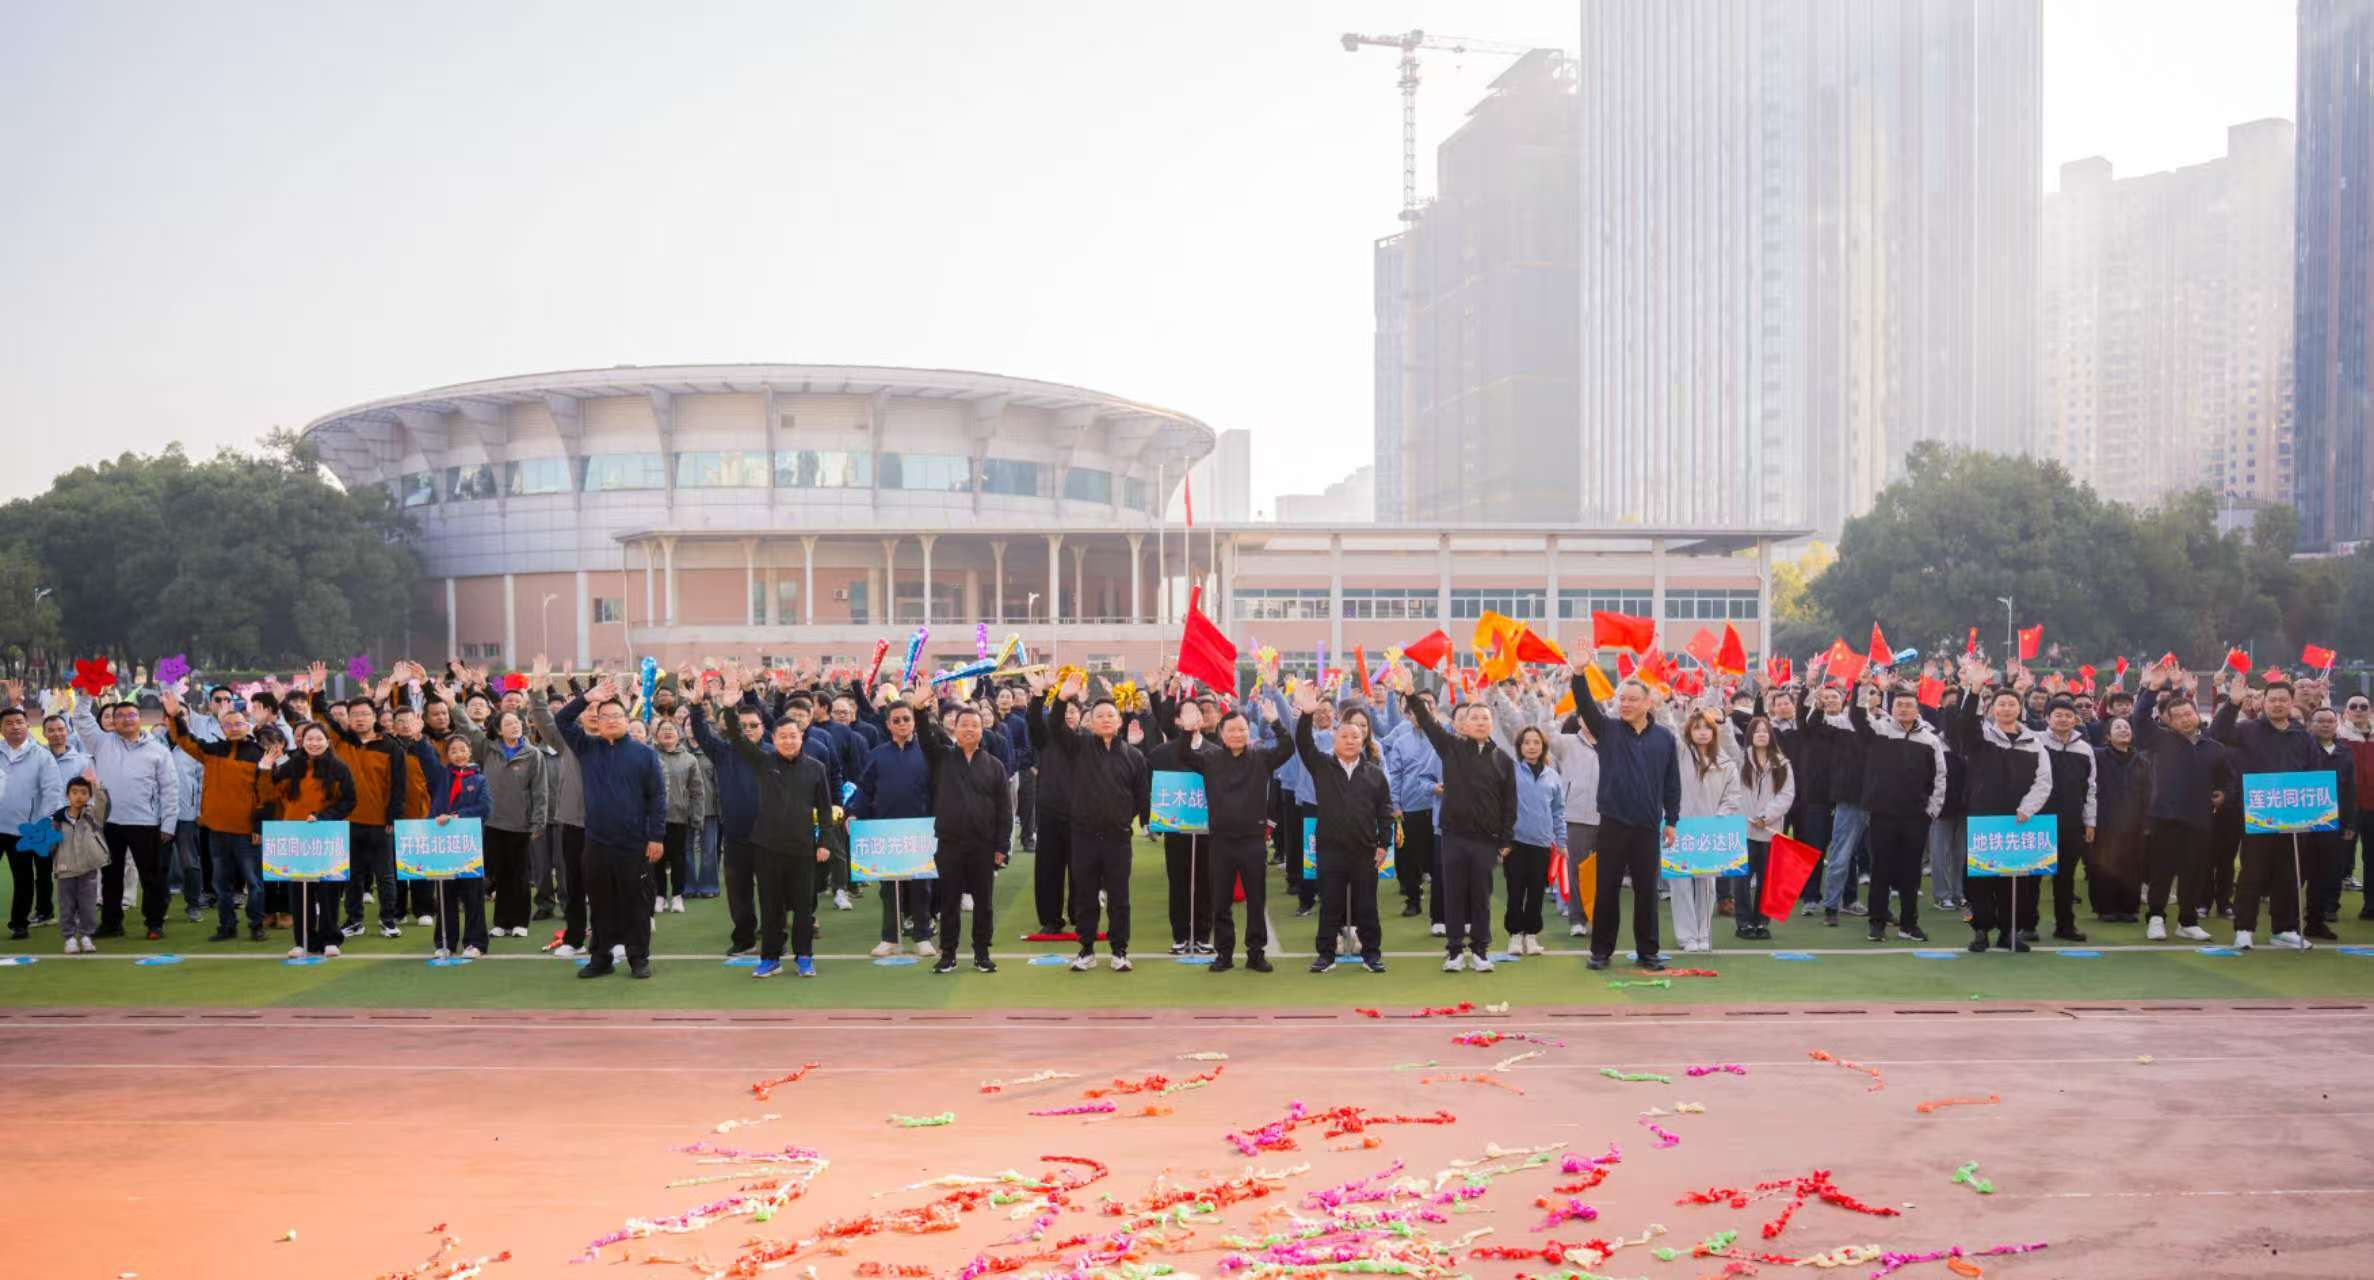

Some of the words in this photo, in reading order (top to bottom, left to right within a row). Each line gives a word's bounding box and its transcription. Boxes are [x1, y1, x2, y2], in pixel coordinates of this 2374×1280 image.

[1973, 831, 2053, 851] 地铁先锋队
